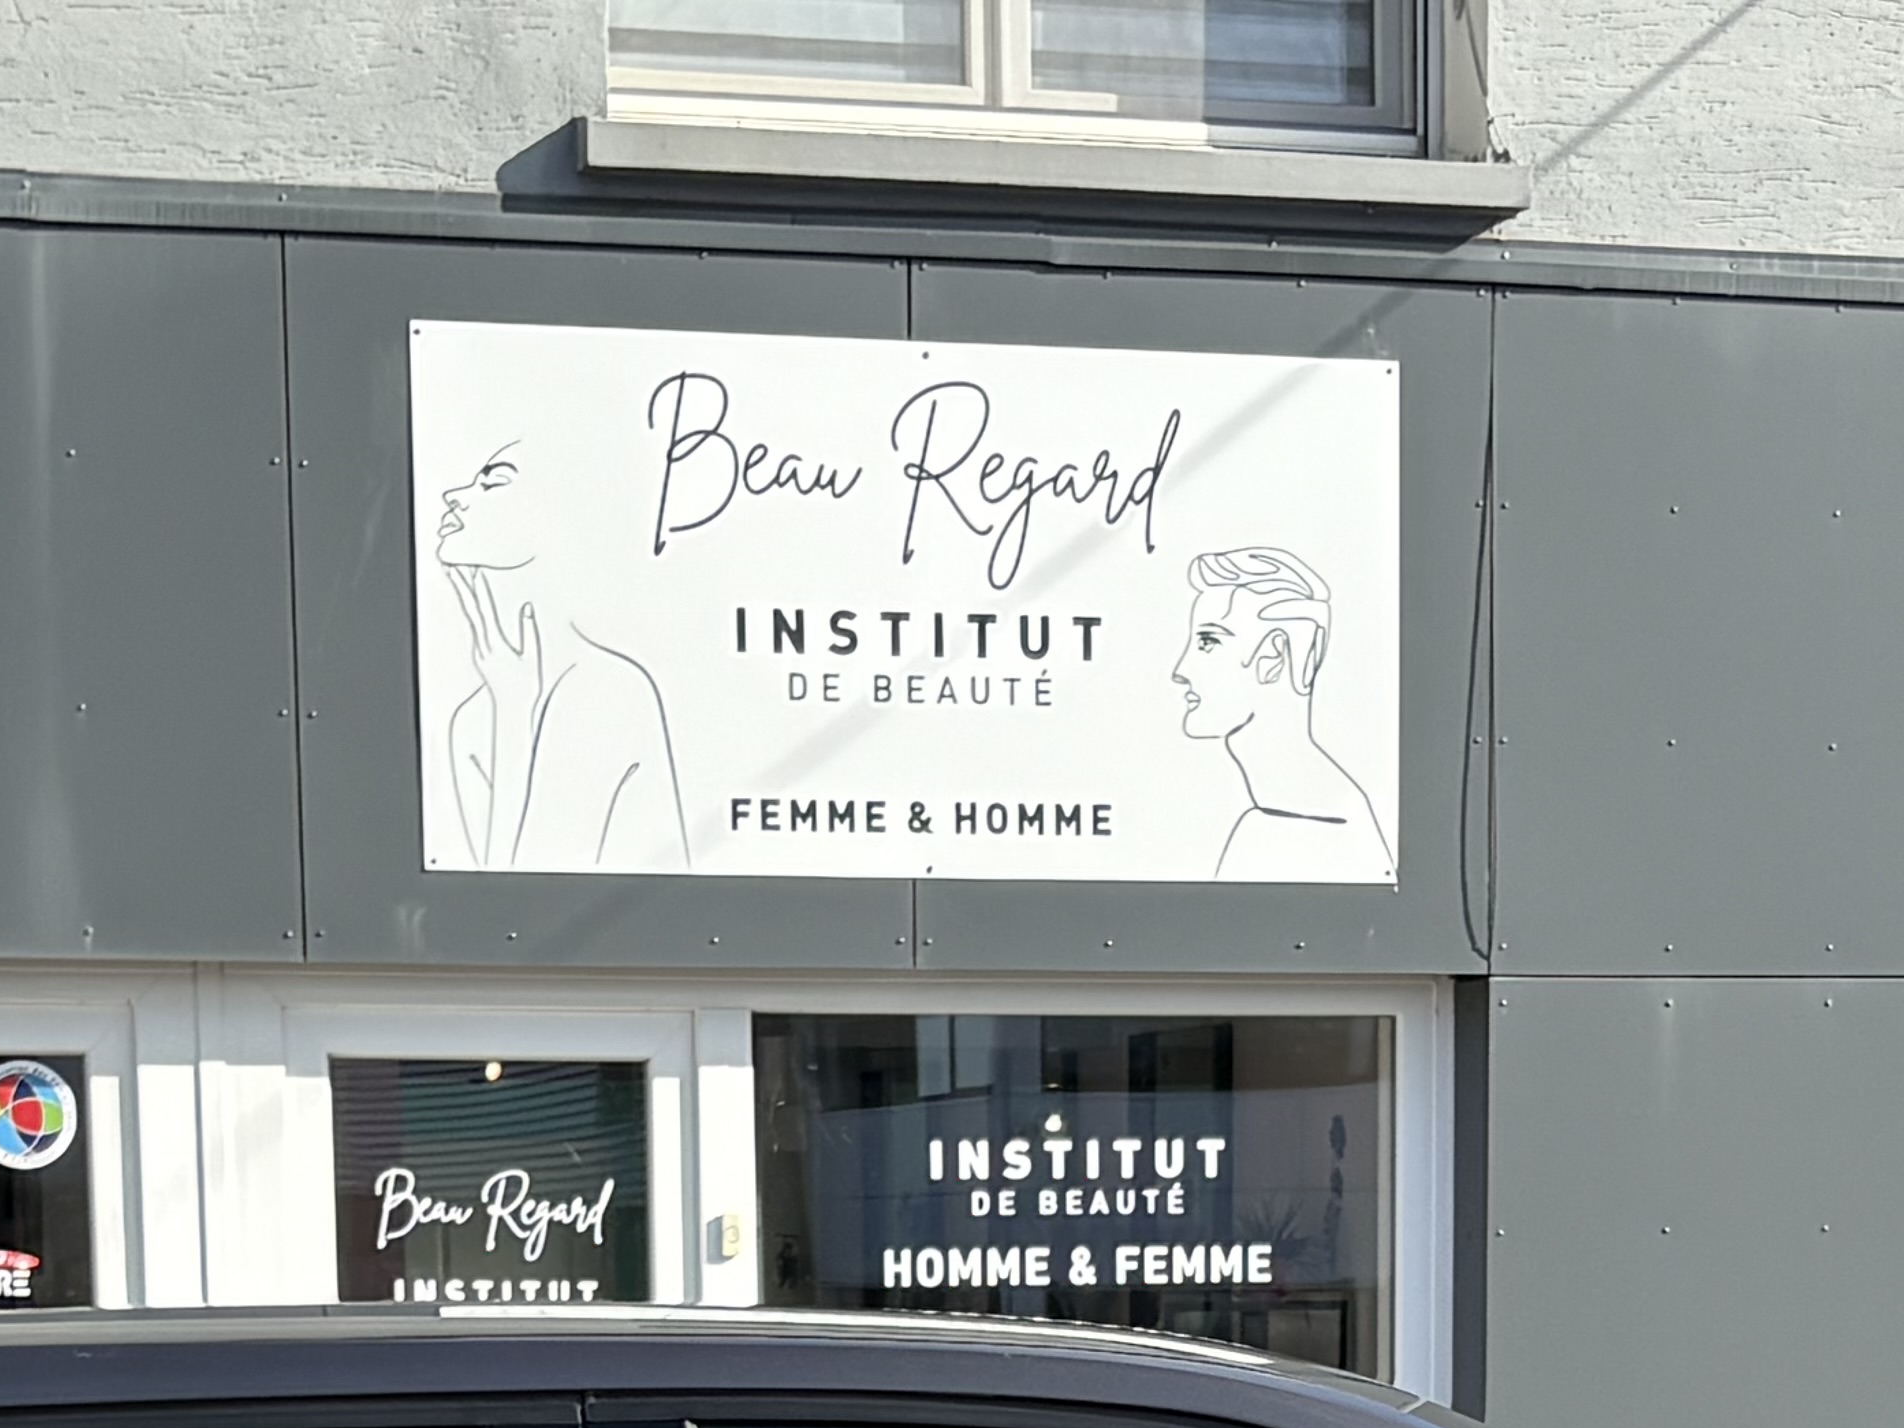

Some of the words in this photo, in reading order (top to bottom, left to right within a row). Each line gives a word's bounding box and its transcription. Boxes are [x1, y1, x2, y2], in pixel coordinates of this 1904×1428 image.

[648, 371, 864, 556] Beau
[891, 380, 1182, 590] Regard
[735, 607, 1104, 662] INSTITUT
[788, 671, 843, 703] DE
[872, 668, 1057, 708] BEAUTÉ
[730, 796, 889, 835] FEMME
[907, 800, 934, 835] &
[954, 801, 1114, 837] HOMME
[928, 1136, 1228, 1182] INSTITUT
[373, 1167, 474, 1251] Beau
[480, 1168, 616, 1263] Regard
[970, 1189, 1018, 1218] DE
[1038, 1183, 1186, 1217] BEAUTÉ
[882, 1245, 1052, 1288] HOMME
[1068, 1247, 1099, 1287] &
[1114, 1243, 1274, 1287] FEMME
